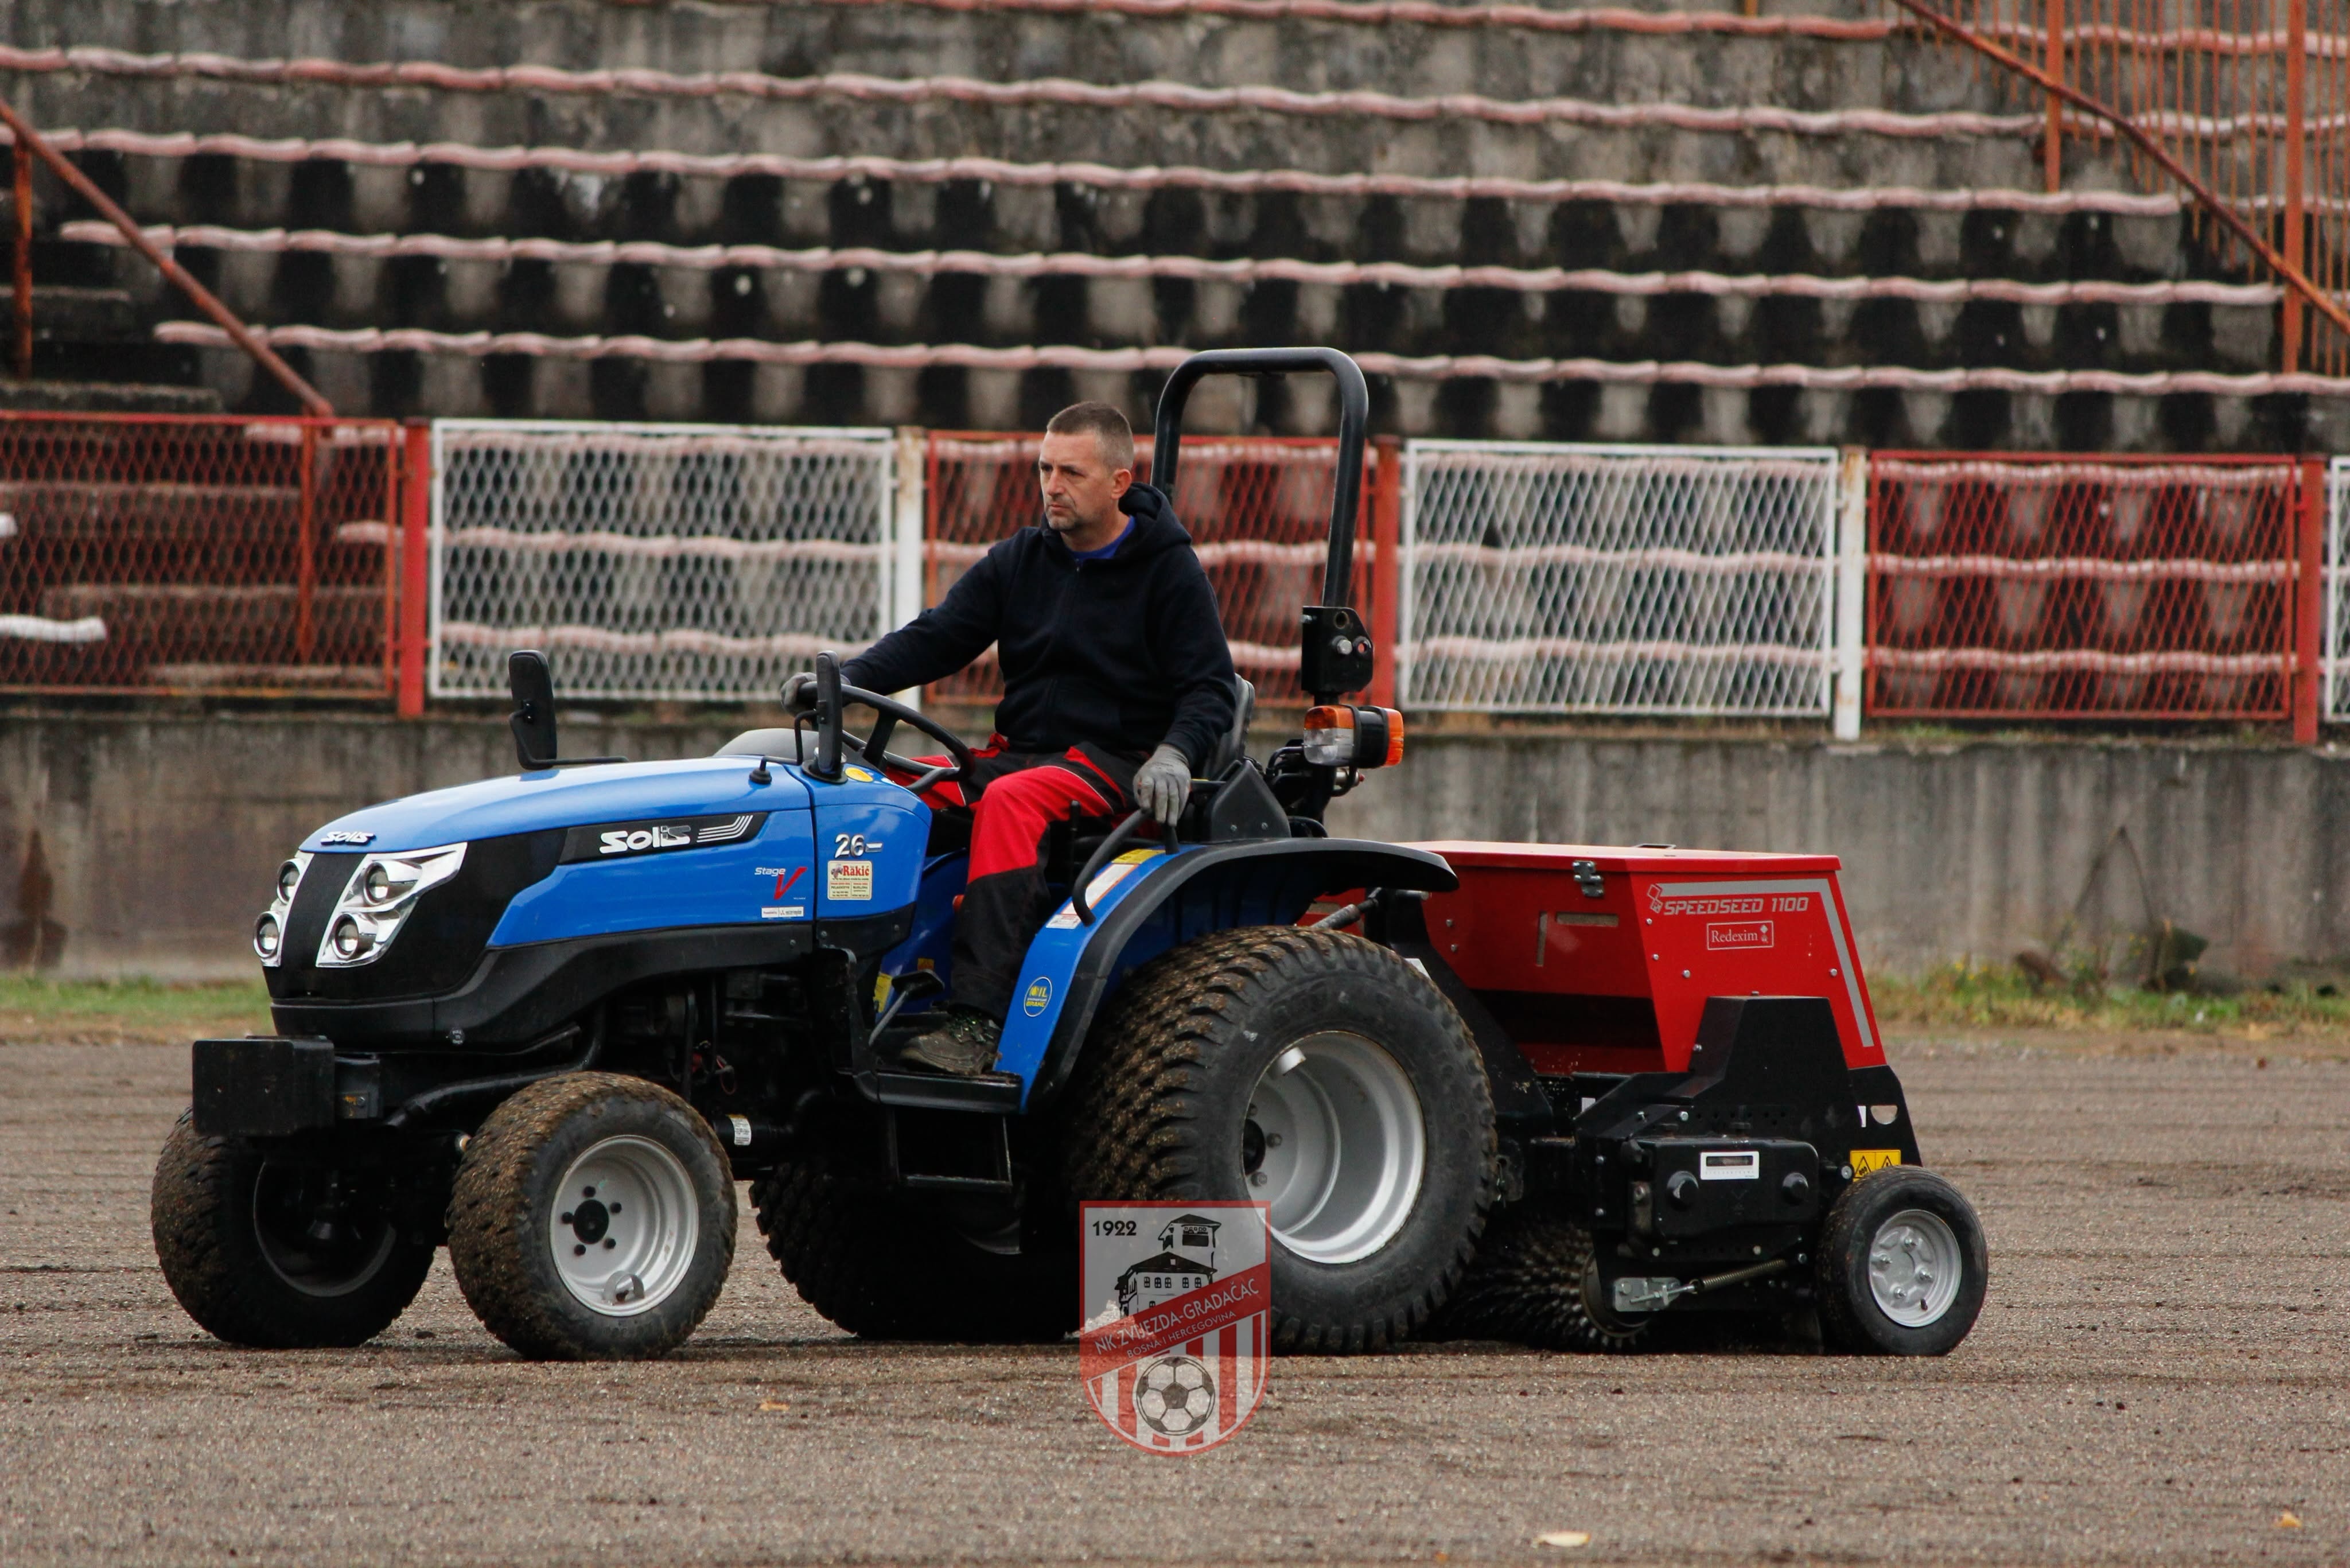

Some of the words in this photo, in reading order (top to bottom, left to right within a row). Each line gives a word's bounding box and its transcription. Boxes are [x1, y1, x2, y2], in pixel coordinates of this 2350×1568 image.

[834, 833, 864, 858] 26
[754, 867, 786, 877] Stage
[773, 866, 808, 900] V
[1663, 898, 1764, 916] SPEEDSEED
[1772, 896, 1809, 913] 1100
[1711, 928, 1758, 943] Redexim
